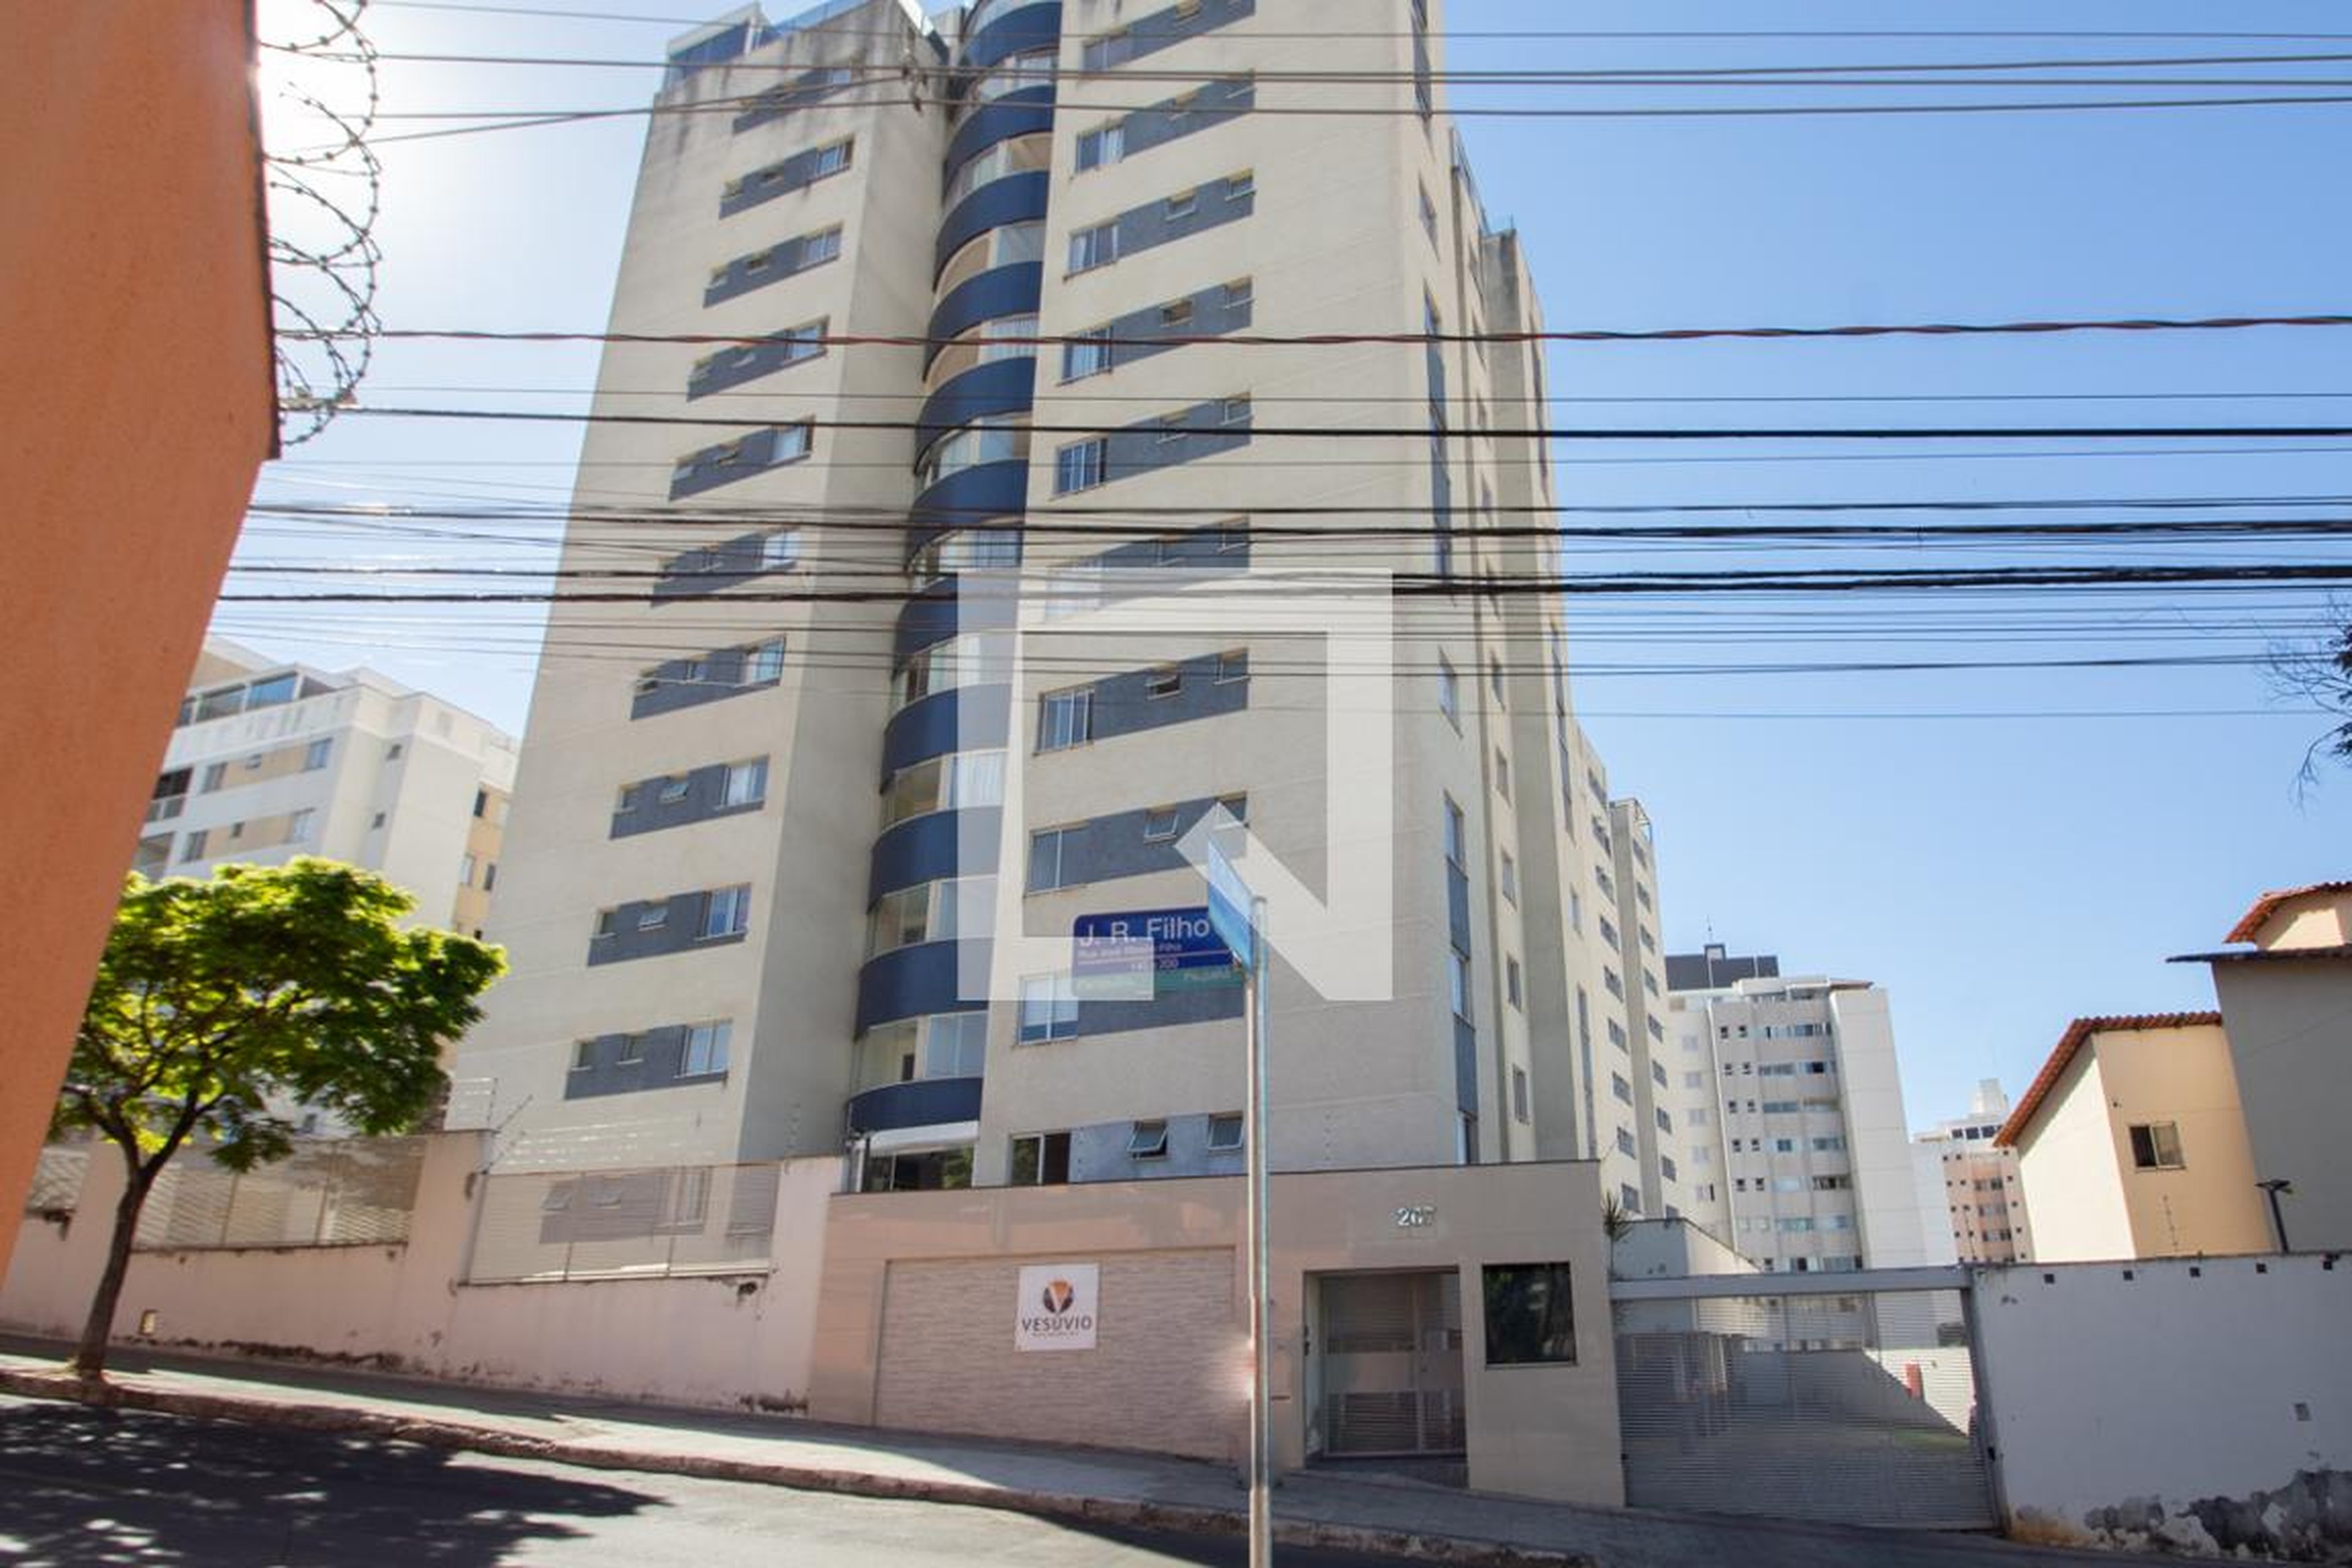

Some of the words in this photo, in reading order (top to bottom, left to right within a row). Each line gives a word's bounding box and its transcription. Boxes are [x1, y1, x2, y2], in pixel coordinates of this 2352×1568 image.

[1079, 924, 1101, 947] J.
[1146, 916, 1210, 941] Filho
[1022, 1315, 1092, 1332] VESUVIO
